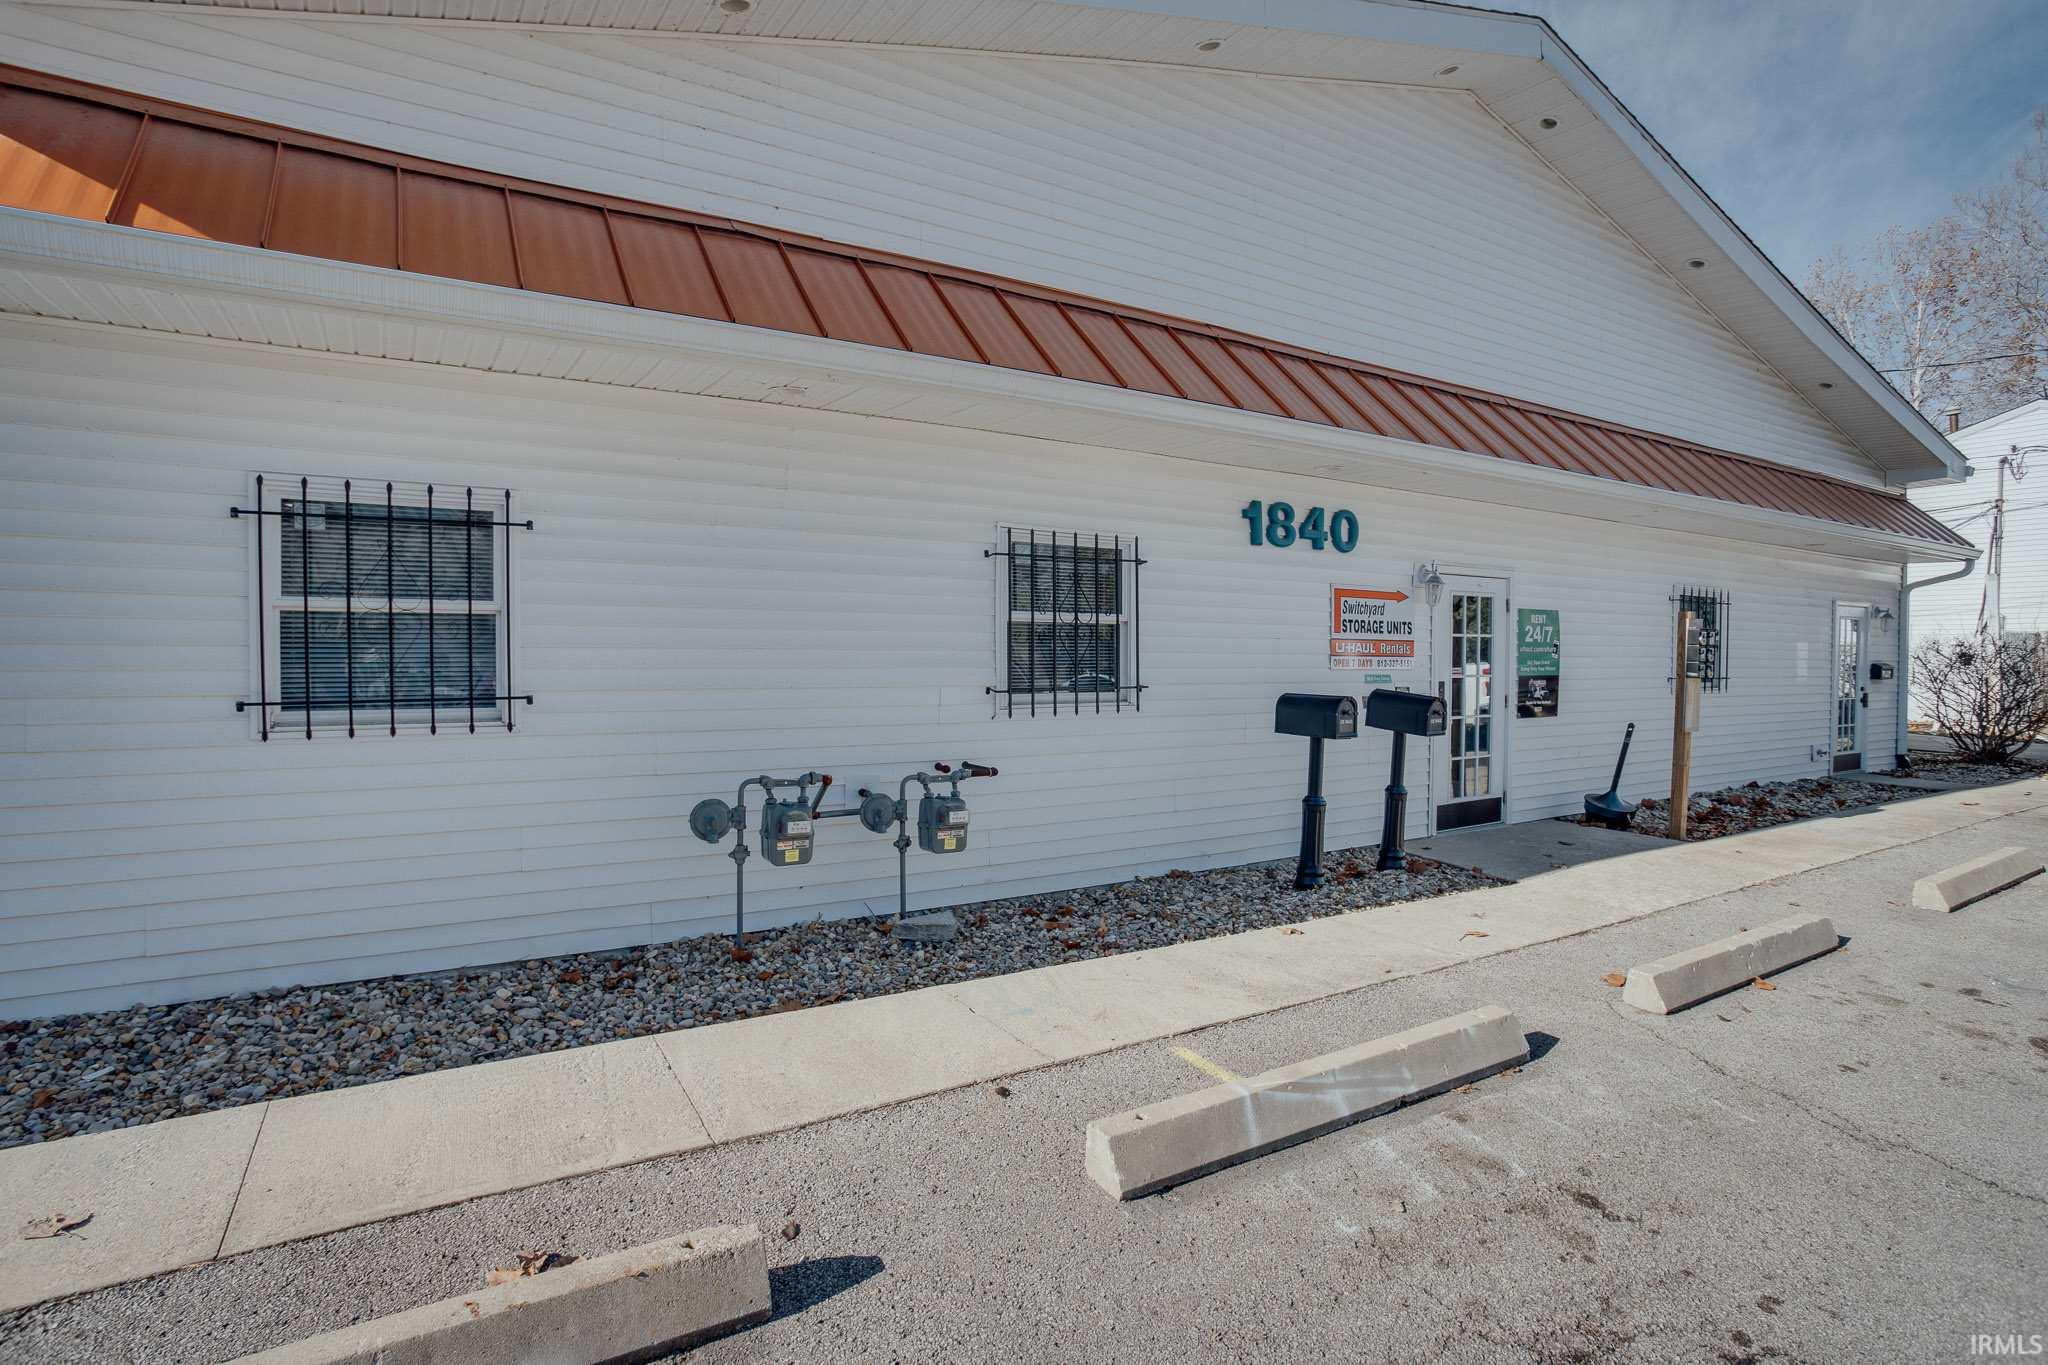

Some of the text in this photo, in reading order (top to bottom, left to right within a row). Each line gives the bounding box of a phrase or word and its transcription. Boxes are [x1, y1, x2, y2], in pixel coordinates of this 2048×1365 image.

[1241, 499, 1359, 553] 1840
[1342, 600, 1386, 618] Switchyard
[1342, 619, 1413, 635] STORAGE UNITS
[1524, 625, 1553, 643] 24/7
[1335, 642, 1411, 655] U-HAUL Rentals
[1357, 658, 1373, 668] DAYS
